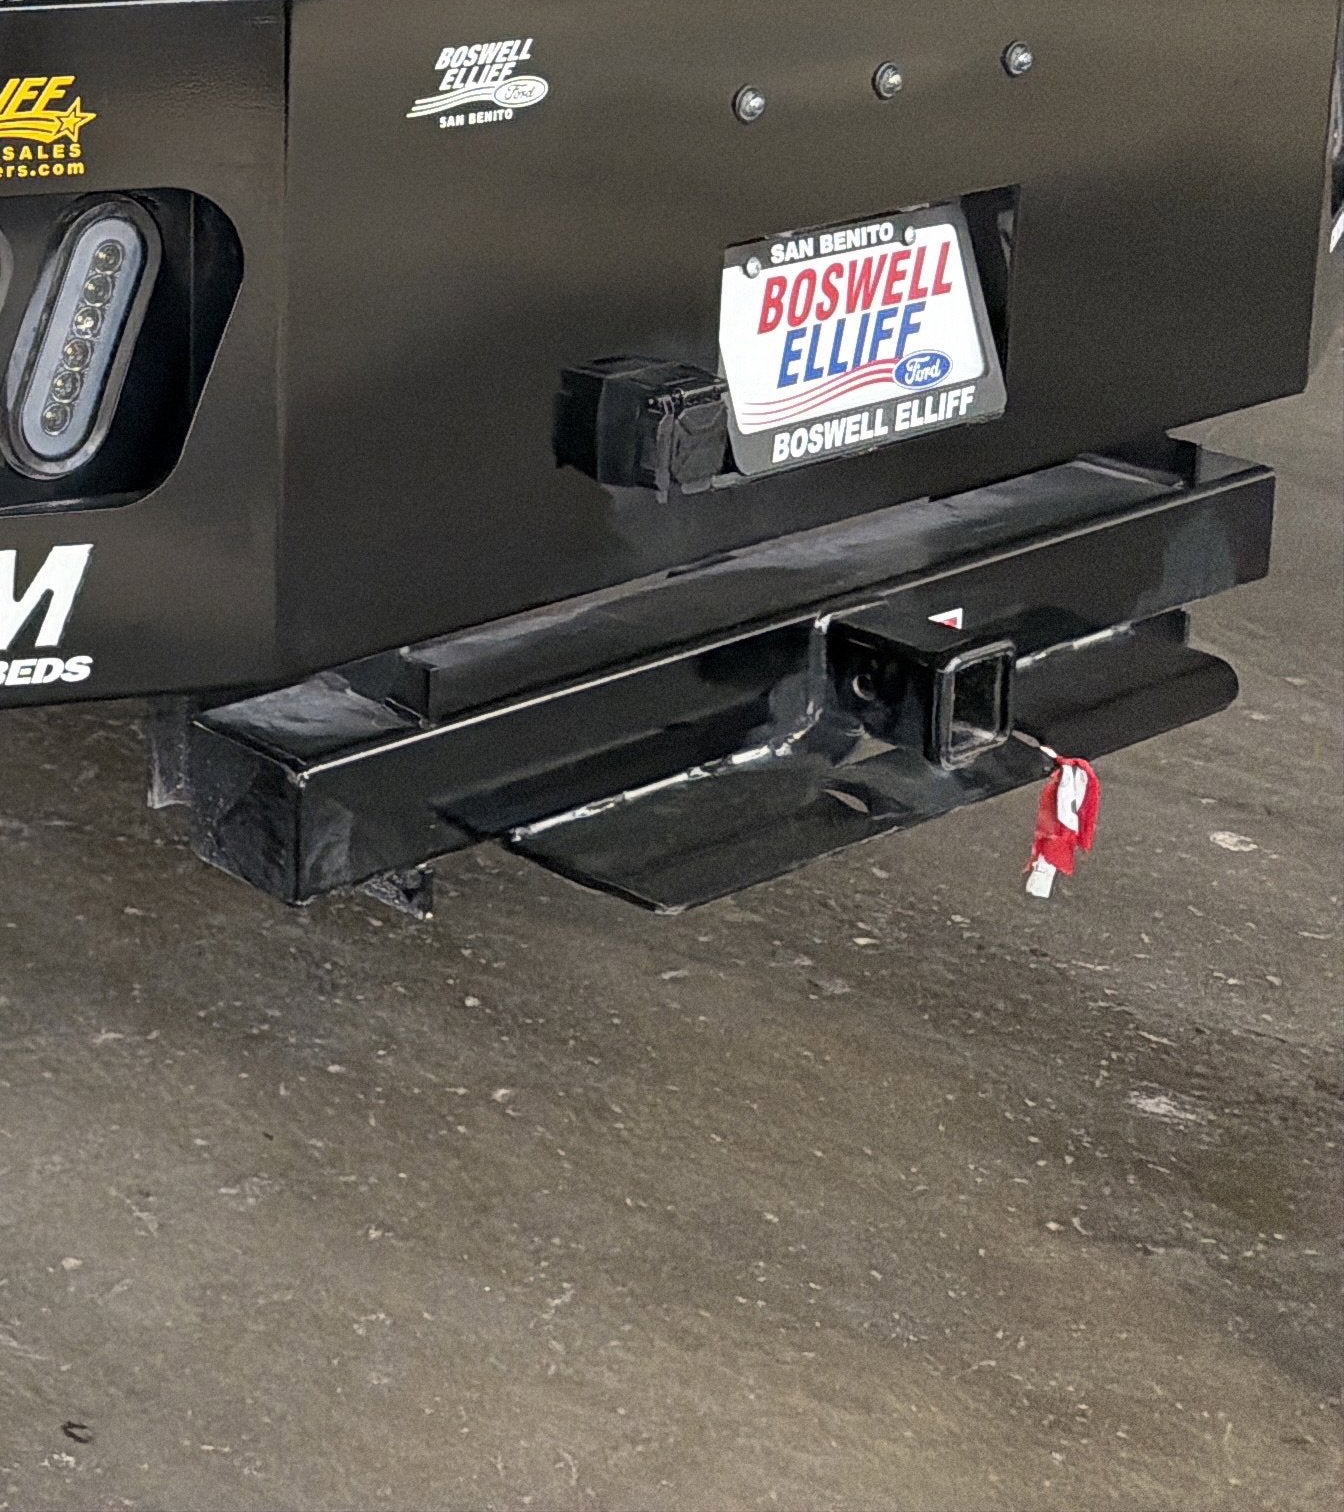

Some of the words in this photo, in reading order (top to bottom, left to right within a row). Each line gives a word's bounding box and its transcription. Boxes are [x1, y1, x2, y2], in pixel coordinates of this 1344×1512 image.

[434, 38, 534, 70] BOSWELL
[439, 113, 465, 129] SAN
[468, 108, 514, 125] BENITO
[2, 143, 82, 161] SALES
[770, 238, 814, 264] SAN
[819, 222, 894, 255] BENITO
[757, 241, 953, 335] BOSWELL
[776, 301, 927, 389] ELLIFF
[903, 356, 942, 386] Ford
[771, 408, 889, 464] BOSWELL
[894, 385, 976, 431] ELLIFF
